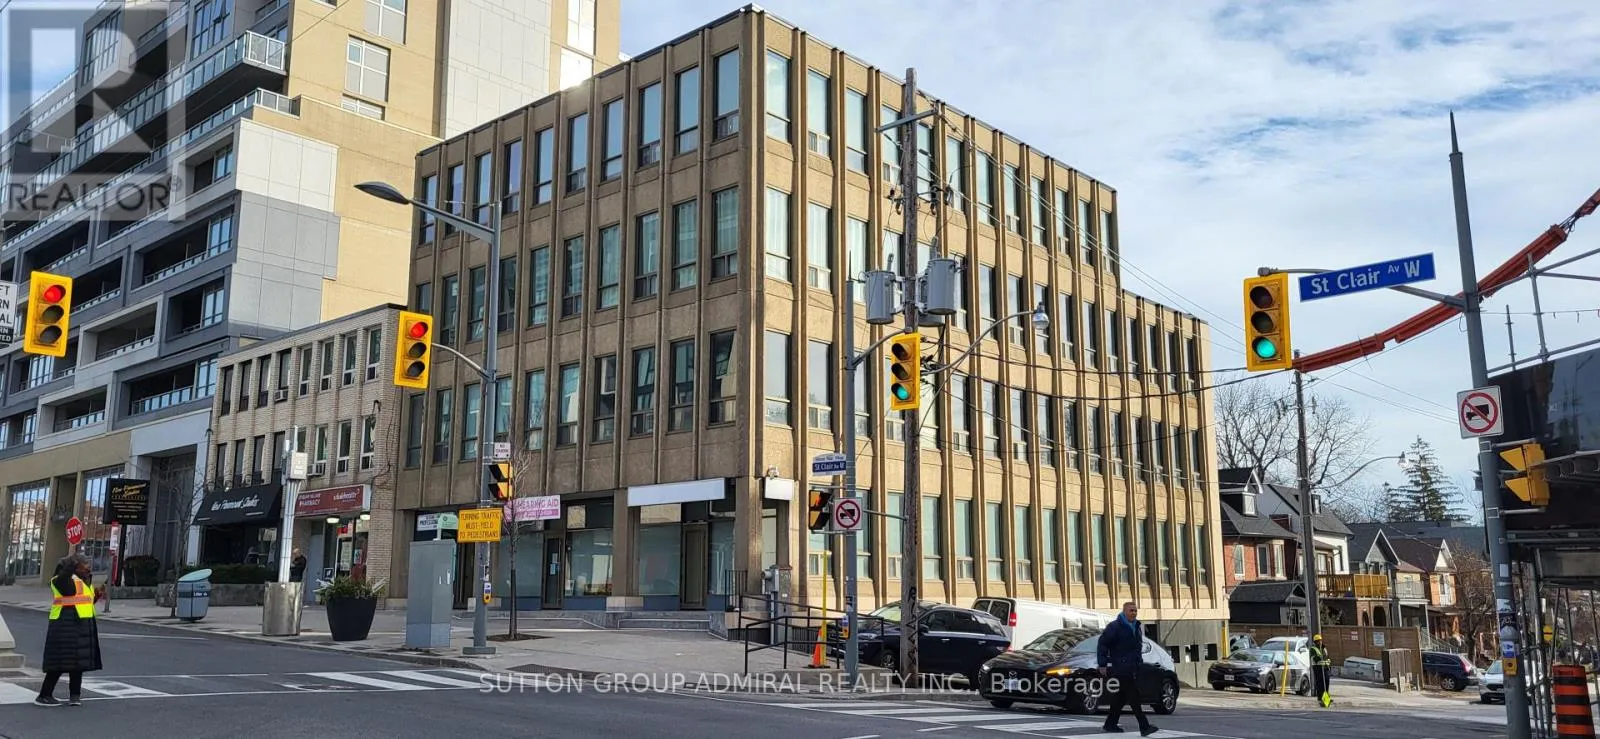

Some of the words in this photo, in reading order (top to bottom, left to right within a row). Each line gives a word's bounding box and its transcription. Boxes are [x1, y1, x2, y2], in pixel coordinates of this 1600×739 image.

[1311, 277, 1330, 295] St
[1337, 267, 1381, 290] Clair
[1387, 264, 1400, 274] Av
[1404, 259, 1420, 279] W
[547, 498, 559, 507] AID
[461, 512, 480, 521] TURNING
[481, 511, 500, 520] TRAFFIC
[465, 522, 478, 530] MUST
[480, 521, 494, 529] YIELD
[67, 524, 82, 539] STOP
[468, 530, 499, 539] PEDESTRIANS
